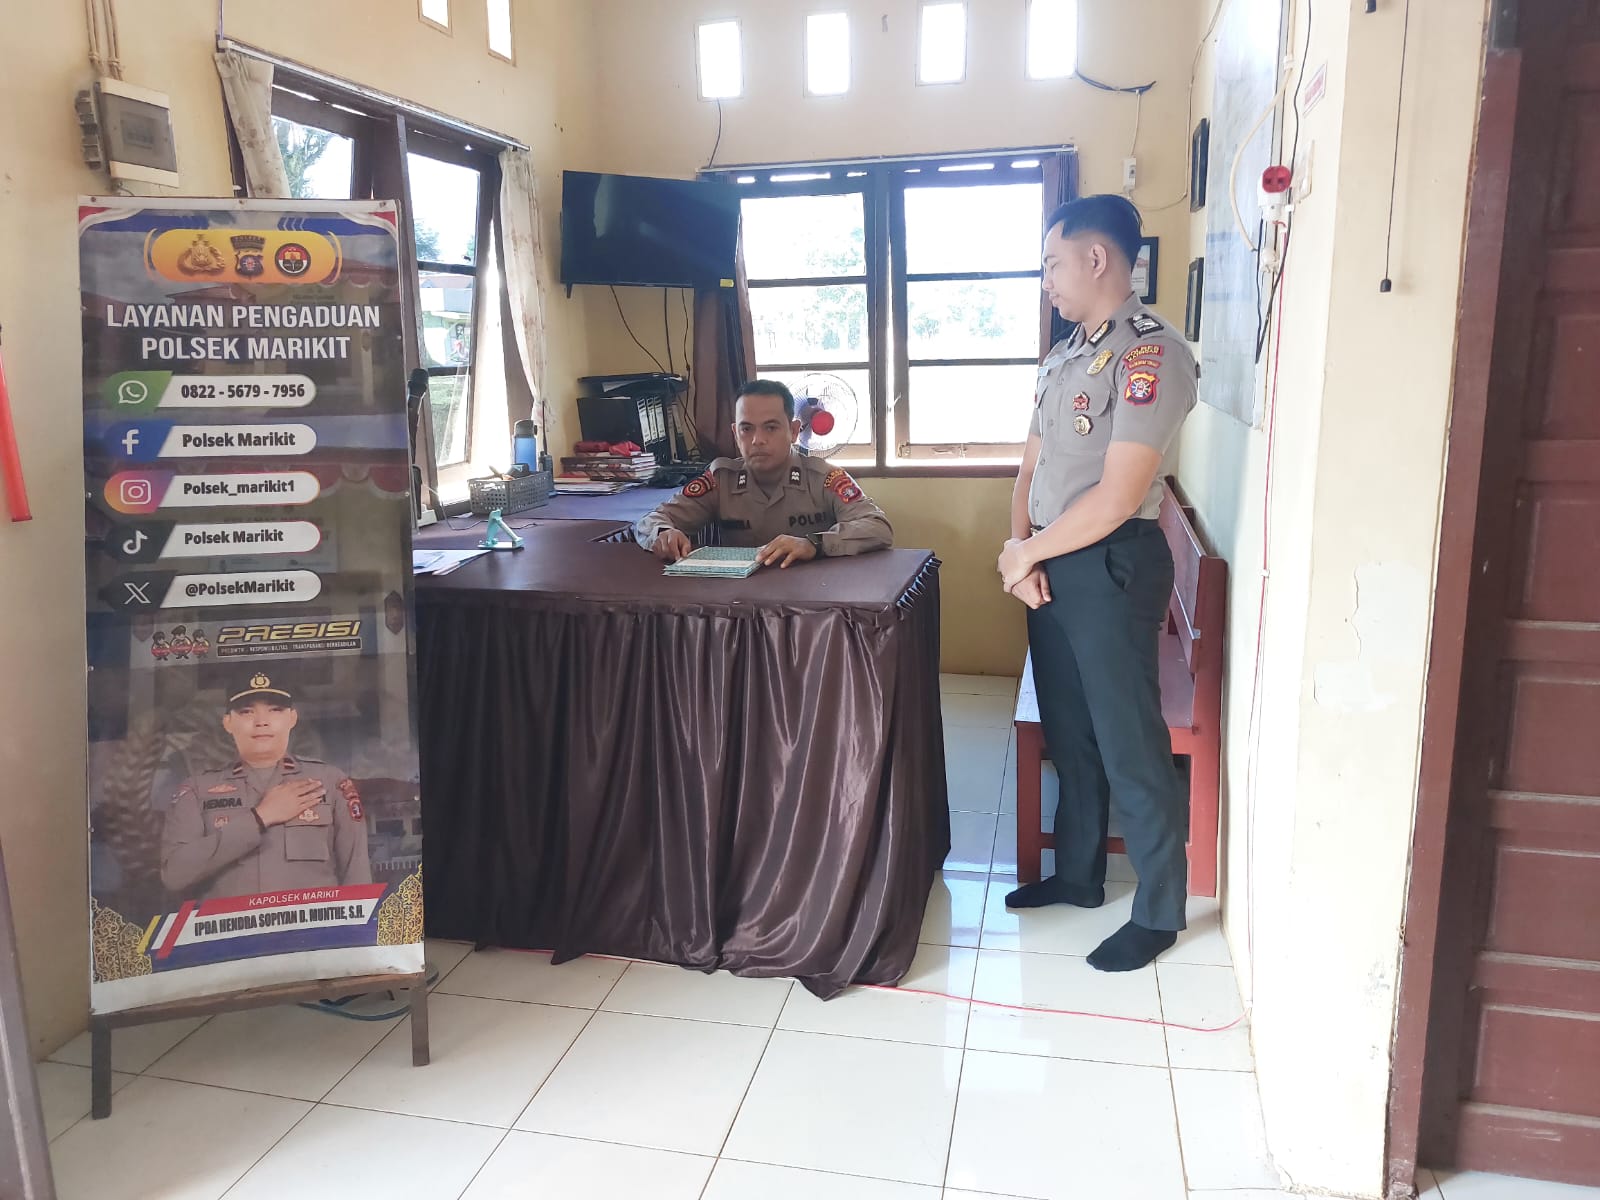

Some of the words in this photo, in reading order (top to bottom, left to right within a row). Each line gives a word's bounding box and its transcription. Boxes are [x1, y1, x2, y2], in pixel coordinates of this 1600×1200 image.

[106, 304, 224, 328] LAYANAN
[232, 305, 380, 328] PENGADUAN
[142, 336, 240, 360] POLSEK
[248, 336, 350, 359] MARIKIT
[181, 384, 216, 399] 0822
[227, 384, 261, 399] 5679
[272, 383, 306, 398] 7956
[182, 432, 235, 448] Polsek
[237, 431, 296, 447] Marikit
[183, 479, 295, 497] Polsek_marikit1
[184, 531, 230, 545] Polsek
[232, 529, 284, 544] Marikit
[185, 578, 295, 597] @PolsekMarikit
[217, 620, 361, 643] PRESISI
[203, 797, 242, 810] HENDRA
[248, 893, 300, 907] KAPOLSEK
[302, 889, 341, 900] MARIKIT
[194, 922, 218, 937] IPDA
[219, 914, 257, 934] HENDRA
[258, 909, 298, 929] SOPIYAN
